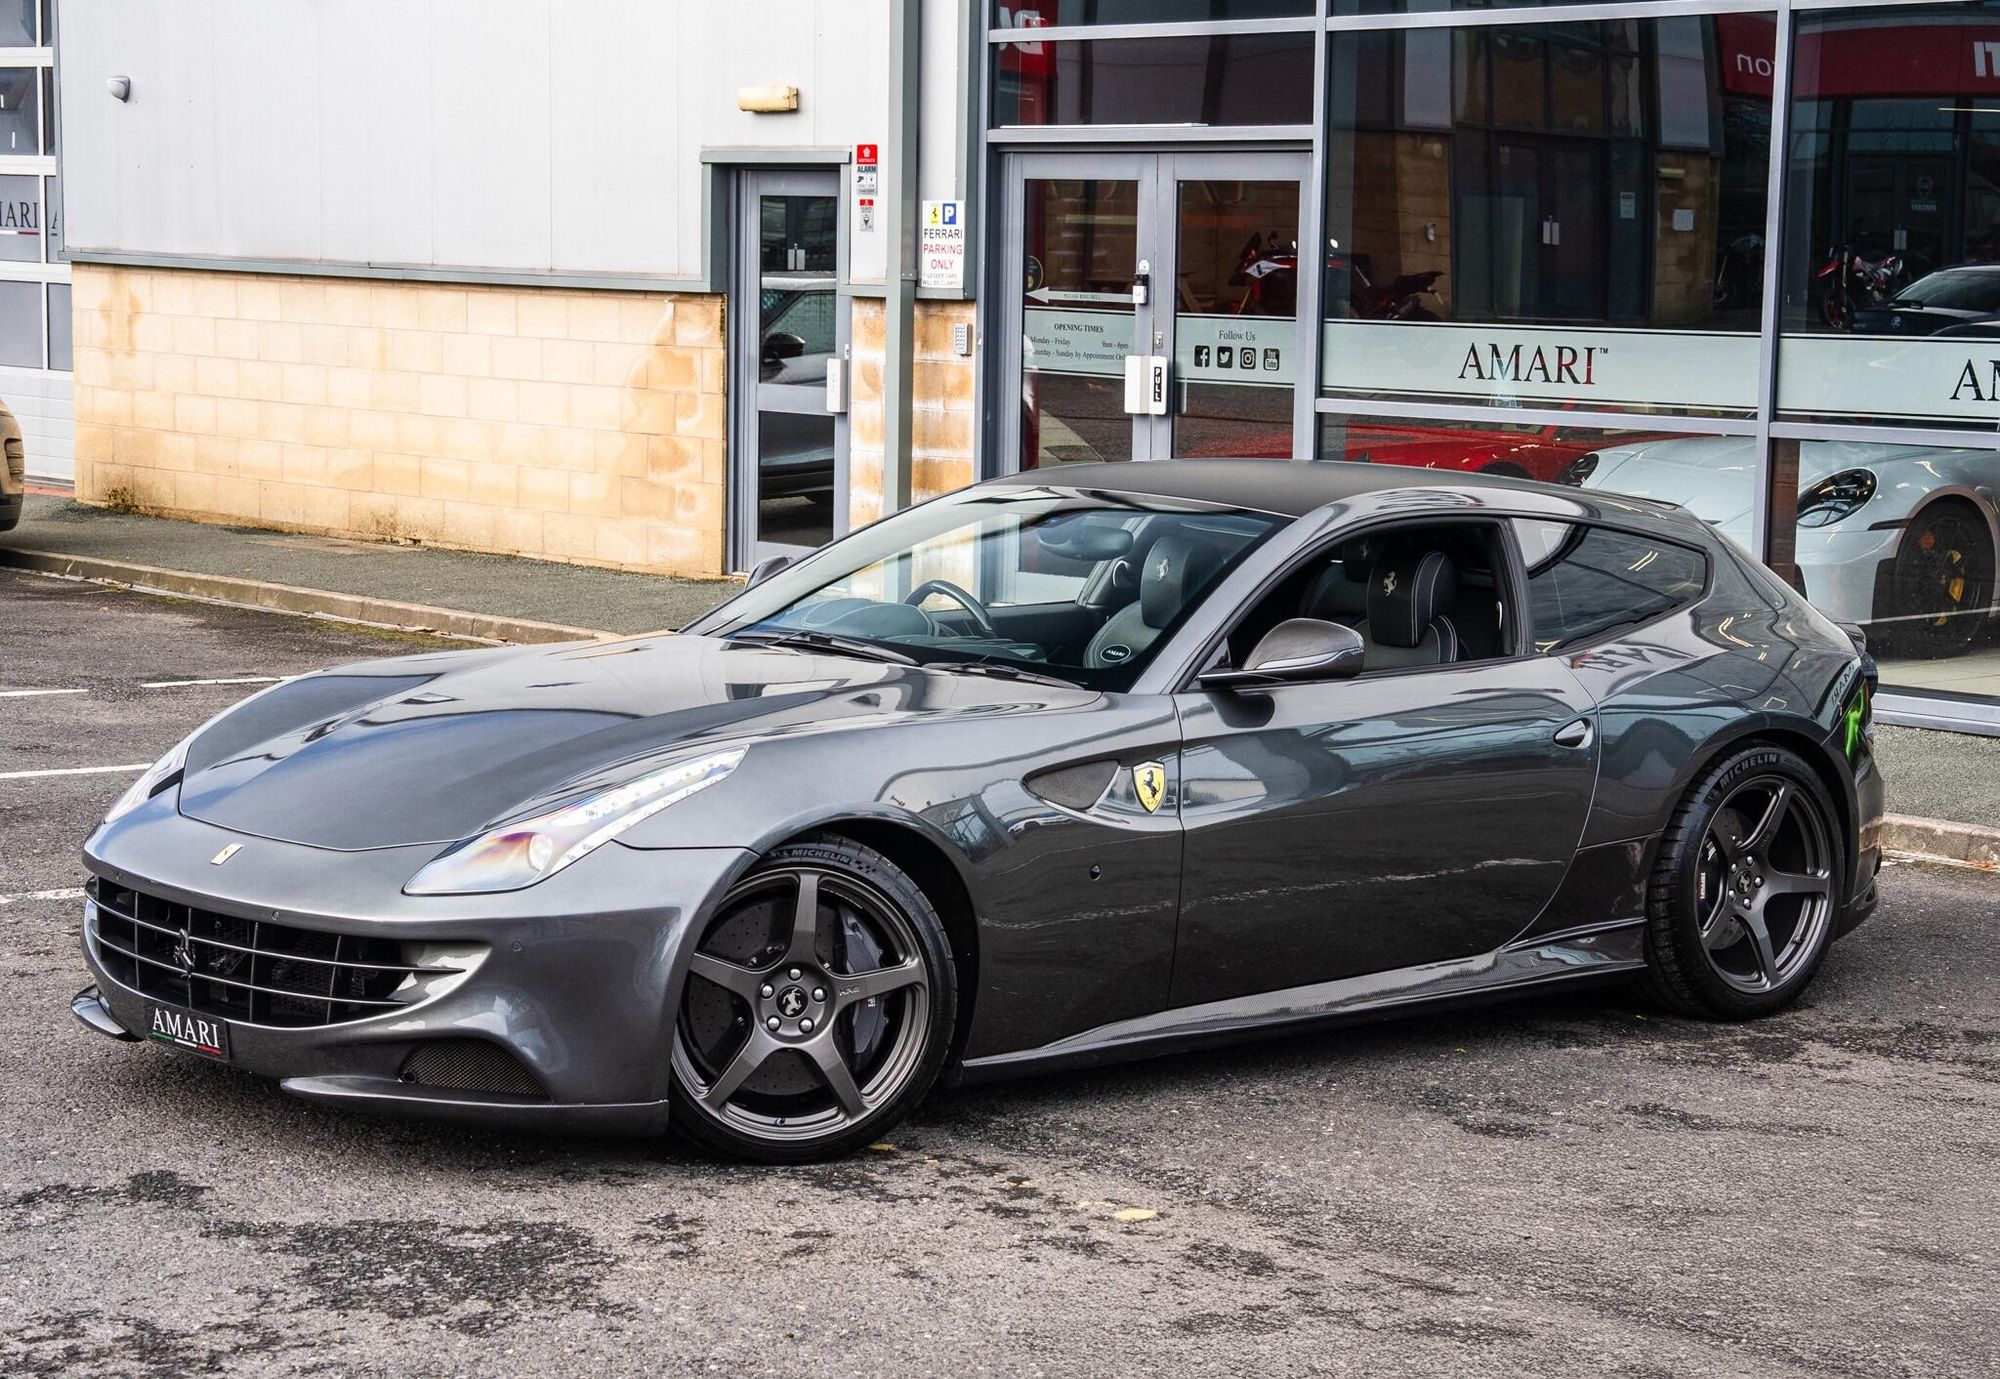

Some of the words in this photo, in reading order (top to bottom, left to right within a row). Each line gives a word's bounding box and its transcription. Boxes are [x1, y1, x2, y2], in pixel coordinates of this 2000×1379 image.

[857, 165, 877, 173] ALARM
[0, 201, 39, 229] ARI
[923, 228, 963, 240] FERRARI
[923, 243, 963, 255] PARKING
[931, 258, 954, 270] ONLY
[1054, 323, 1083, 332] OPENING
[1084, 324, 1104, 333] TIMES
[1030, 336, 1050, 346] Monday
[1054, 337, 1071, 347] Friday
[1218, 330, 1243, 341] Follow
[1245, 331, 1256, 341] Us
[1101, 340, 1113, 348] 9am
[1056, 350, 1074, 359] Sunday
[1074, 350, 1081, 359] by
[1083, 351, 1115, 361] Appointment
[1115, 353, 1126, 361] Onl
[1458, 342, 1597, 385] AMARI
[1720, 753, 1777, 789] MICHELIN
[791, 848, 851, 865] MICHELIN
[152, 1007, 220, 1049] AMARI
